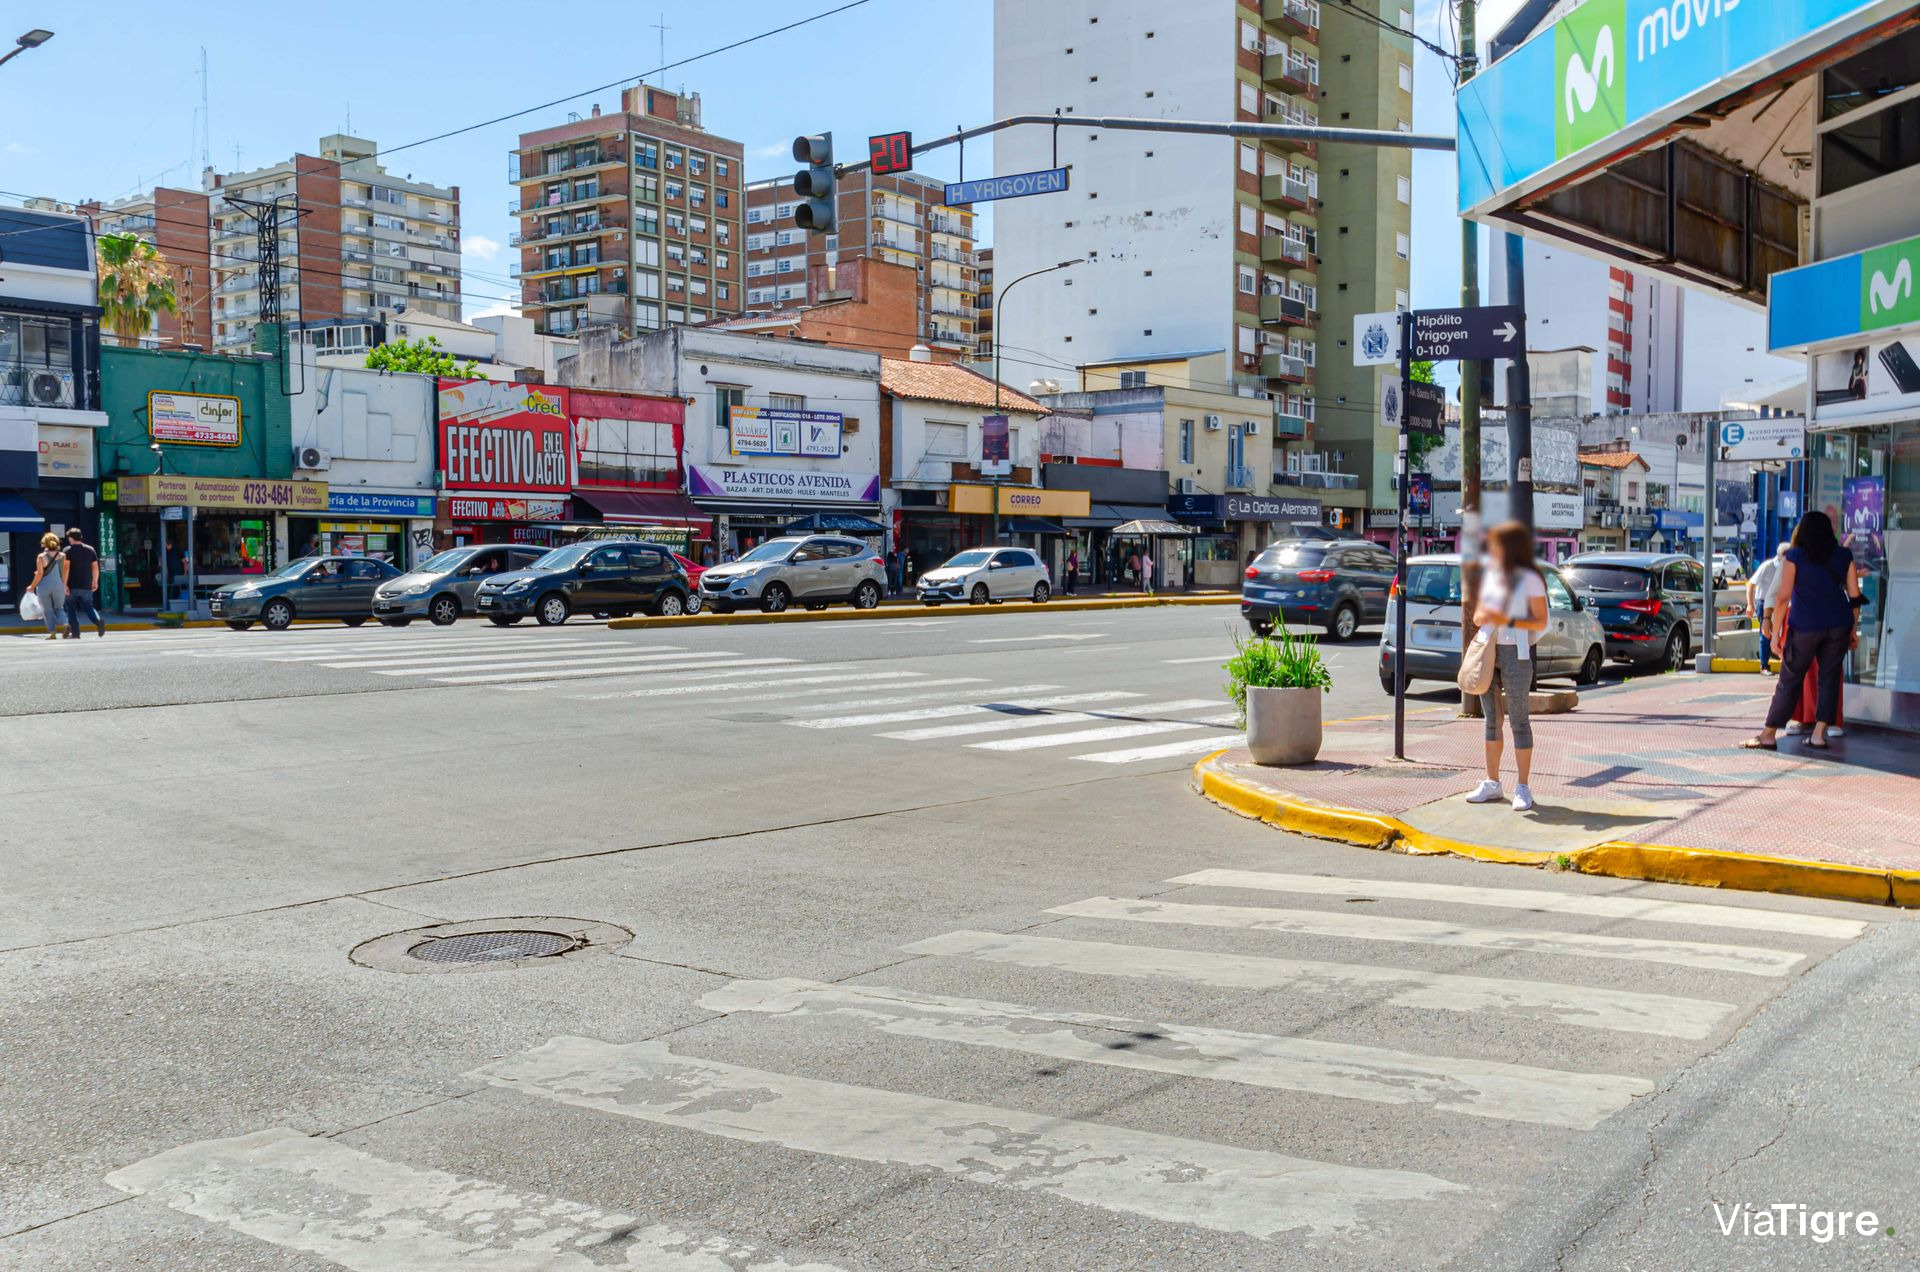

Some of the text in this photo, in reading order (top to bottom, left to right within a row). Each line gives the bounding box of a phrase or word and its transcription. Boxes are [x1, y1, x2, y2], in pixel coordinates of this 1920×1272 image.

[869, 133, 908, 171] 20
[952, 173, 1061, 203] H. YRIGOYEN
[1417, 314, 1463, 328] Hipólito
[1416, 330, 1468, 343] Yrigoyen
[1416, 344, 1450, 356] 0-100
[527, 394, 560, 415] Cred
[201, 402, 233, 422] dinfor
[447, 426, 566, 486] EFECTIVO EN EL ACTO
[158, 481, 187, 490] Porteros
[194, 481, 240, 492] Automatización
[723, 471, 852, 489] PLASTICOS AVENIDA
[156, 492, 188, 502] eléctricos
[243, 484, 294, 505] 4733-4641
[775, 487, 793, 495] BAÑO
[200, 493, 235, 503] de portones
[347, 496, 359, 506] de
[361, 496, 370, 506] la
[372, 497, 415, 508] Provincia
[1010, 495, 1041, 505] CORREO
[452, 501, 488, 517] EFECTIVO
[1240, 501, 1318, 516] La Optica Alemana
[513, 528, 548, 540] EFECTIVO
